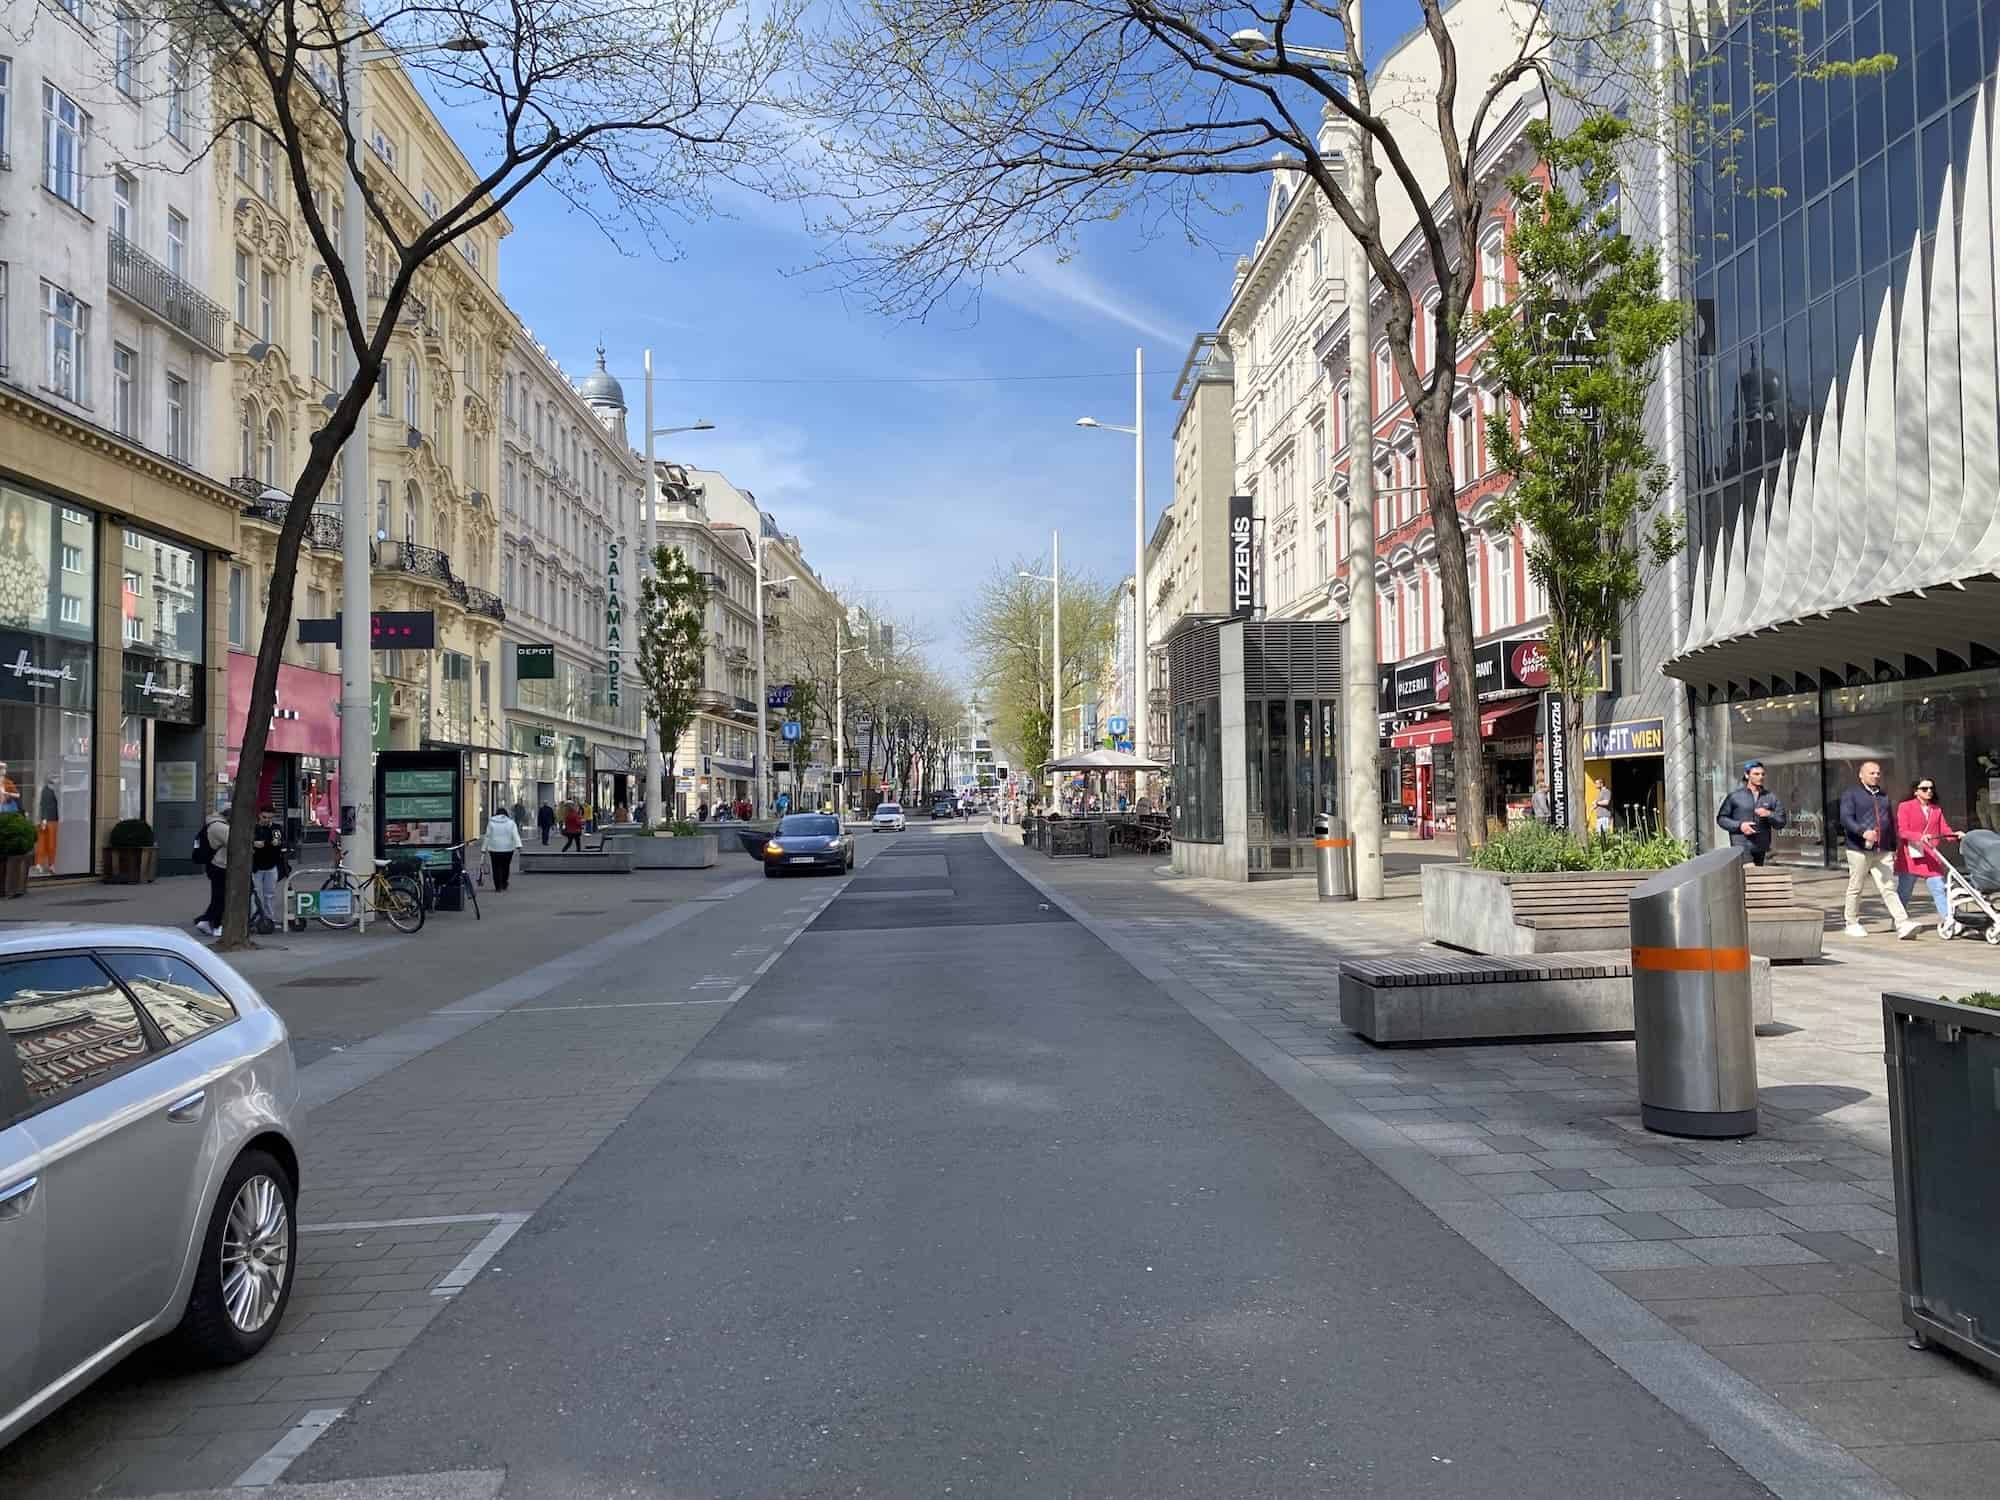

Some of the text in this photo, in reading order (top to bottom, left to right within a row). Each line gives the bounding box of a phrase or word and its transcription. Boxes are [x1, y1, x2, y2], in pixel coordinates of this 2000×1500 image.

[1231, 517, 1251, 611] TEZENIS
[607, 544, 621, 707] SALAMANDER
[518, 648, 553, 656] DEPOT
[1398, 676, 1428, 697] PIZZERIA
[783, 725, 798, 739] U
[1591, 727, 1662, 753] McFIT WIEN
[297, 893, 314, 915] P
